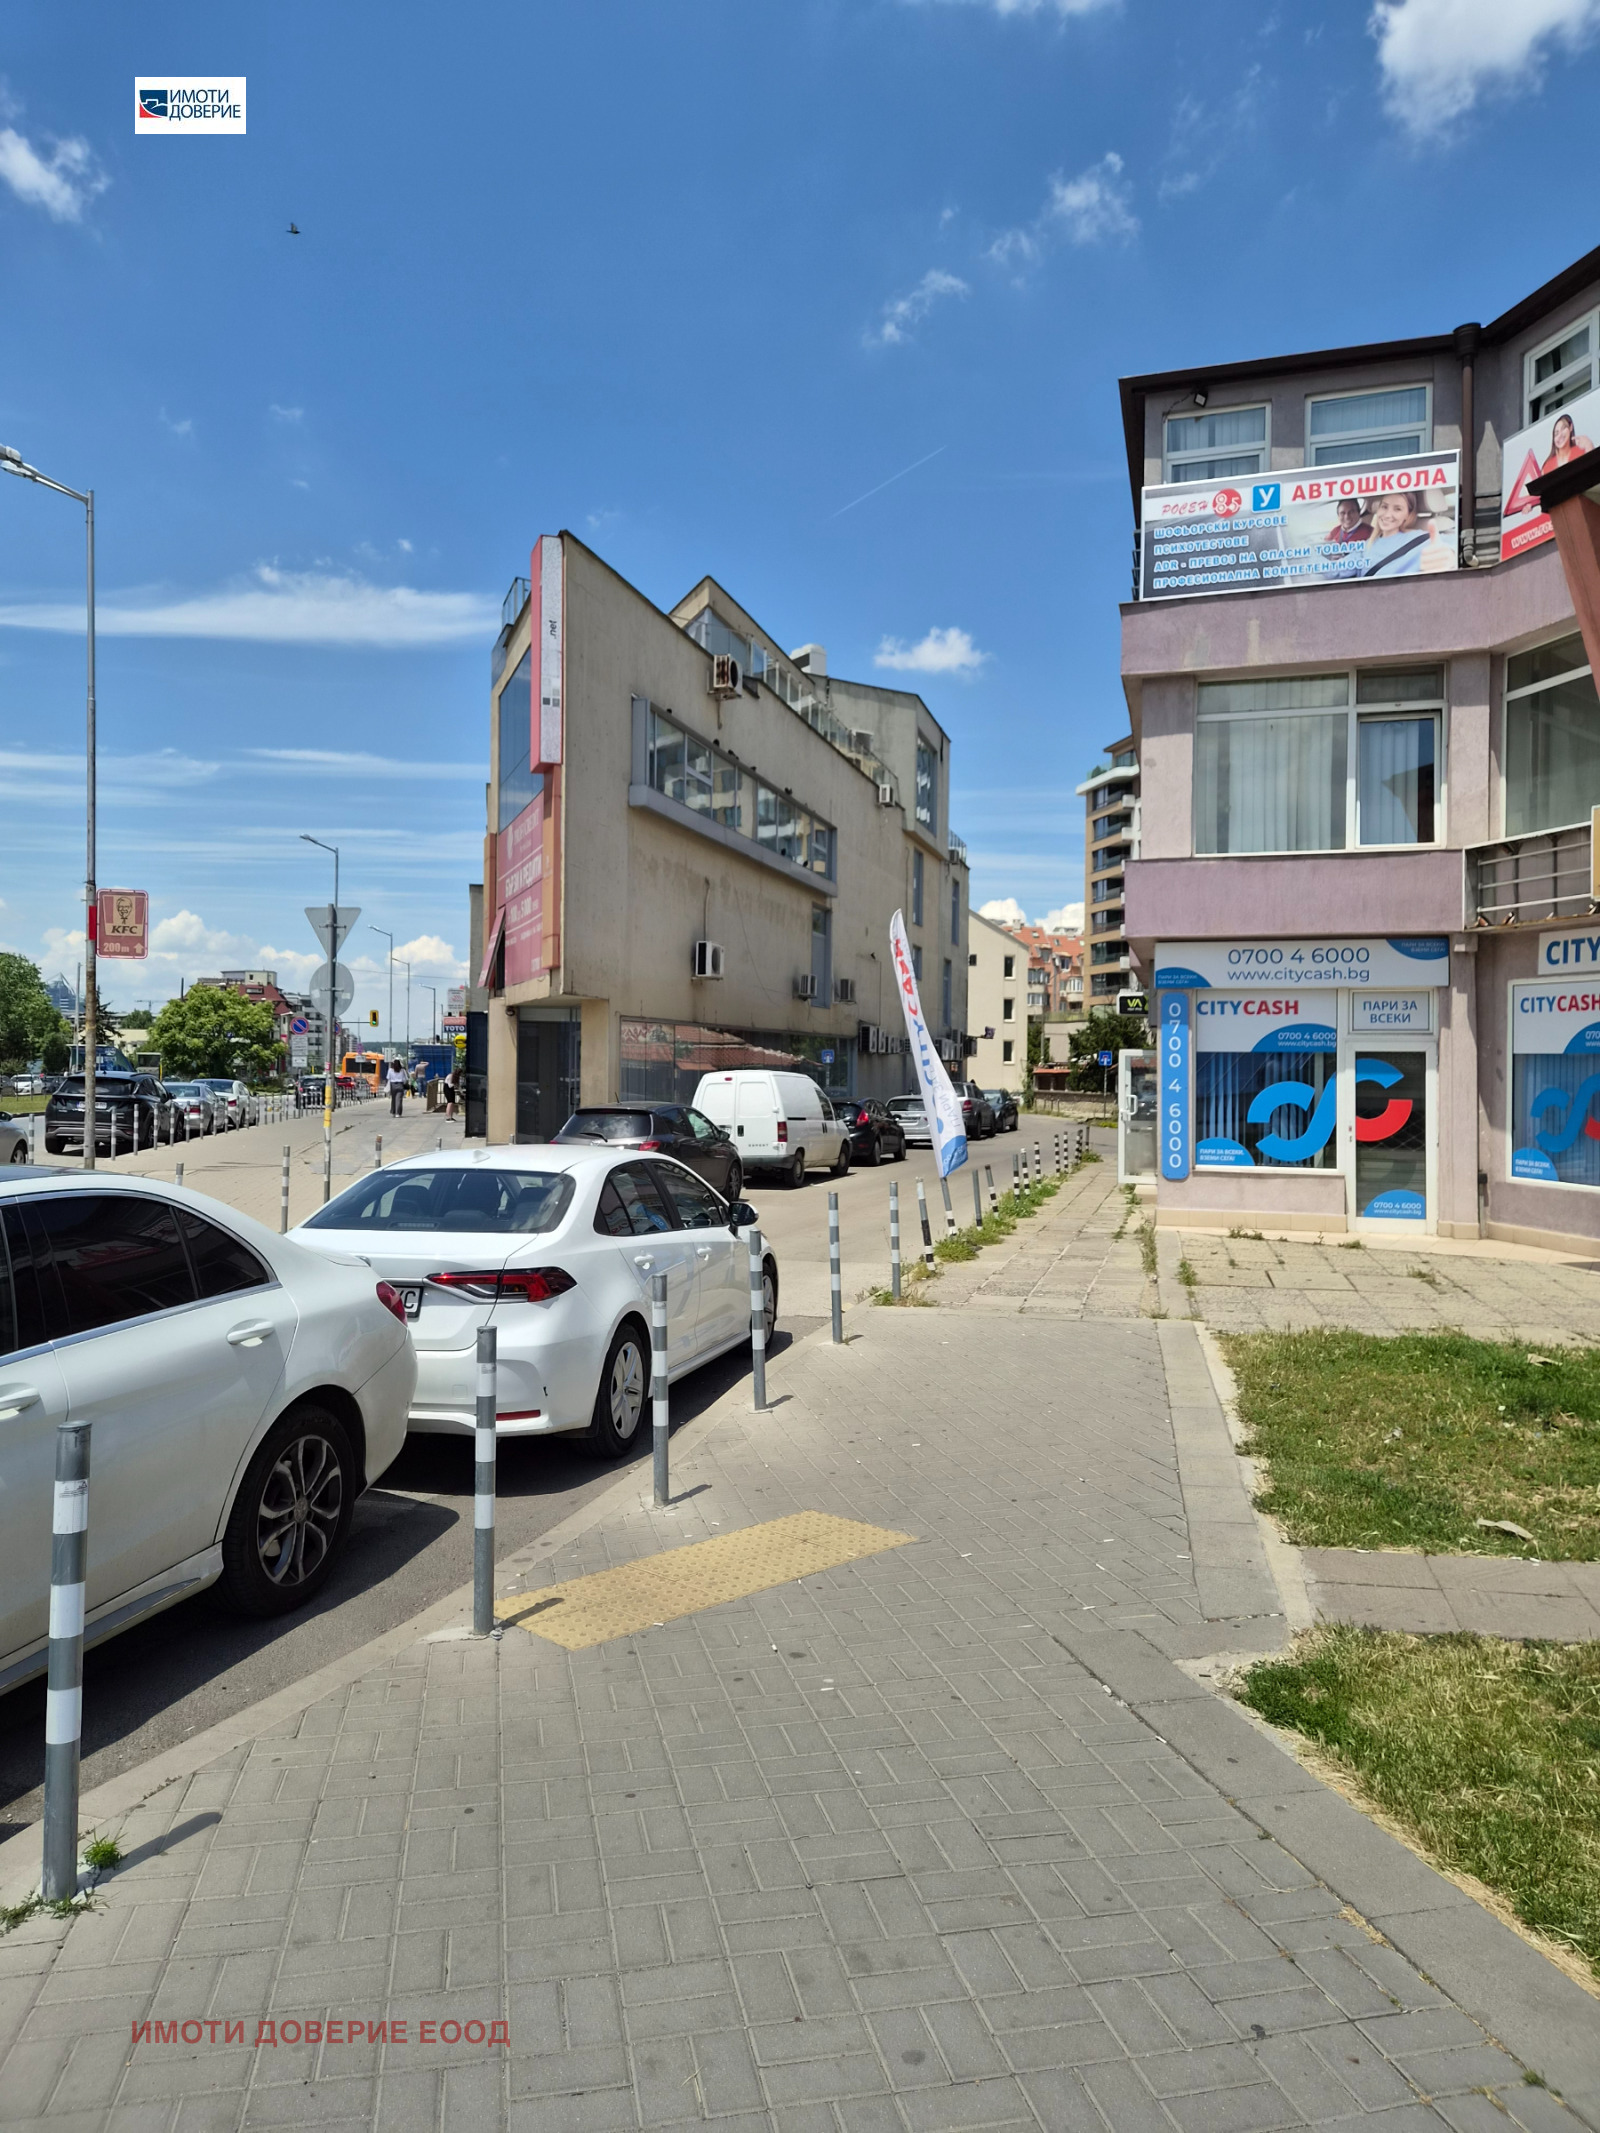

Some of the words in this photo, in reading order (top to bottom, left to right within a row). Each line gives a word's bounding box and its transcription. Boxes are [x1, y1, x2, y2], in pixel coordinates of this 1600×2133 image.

[1161, 500, 1208, 516] РОСЕН
[1214, 492, 1242, 514] 85
[1258, 487, 1275, 507] У
[1291, 468, 1448, 502] АВТОШКОЛА
[1154, 521, 1230, 539] ШОФЬОРСКИ
[1232, 515, 1288, 531] КУРСОВЕ
[1154, 535, 1249, 556] ПСИХОТЕСТОВЕ
[1154, 560, 1178, 572] ADR
[1189, 554, 1237, 569] ПРЕВОЗ
[1239, 551, 1257, 563] НА
[1260, 547, 1311, 561] ОПАСНИ
[1316, 541, 1365, 555] ТОВАРИ
[1153, 568, 1260, 589] ПРОФЕСИОНАЛНА
[1263, 559, 1372, 578] КОМПЕТЕНТНОСТ
[111, 925, 137, 935] KFC
[1228, 949, 1283, 965] 0700
[1290, 949, 1305, 964] 4
[1311, 947, 1370, 963] 6000
[1227, 967, 1370, 982] www.citycash.bg
[1197, 1000, 1299, 1015] CITYCASH
[1363, 1001, 1398, 1011] ПАРИ
[1401, 1000, 1418, 1011] ЗА
[1370, 1013, 1411, 1023] ВСЕКИ
[1168, 1003, 1182, 1068] 0700
[1278, 1032, 1301, 1040] 0700
[1304, 1032, 1311, 1040] 4
[1312, 1032, 1337, 1040] 6000
[1278, 1040, 1337, 1048] www.citycash.bg
[1168, 1079, 1182, 1093] 4
[1168, 1103, 1182, 1168] 6000
